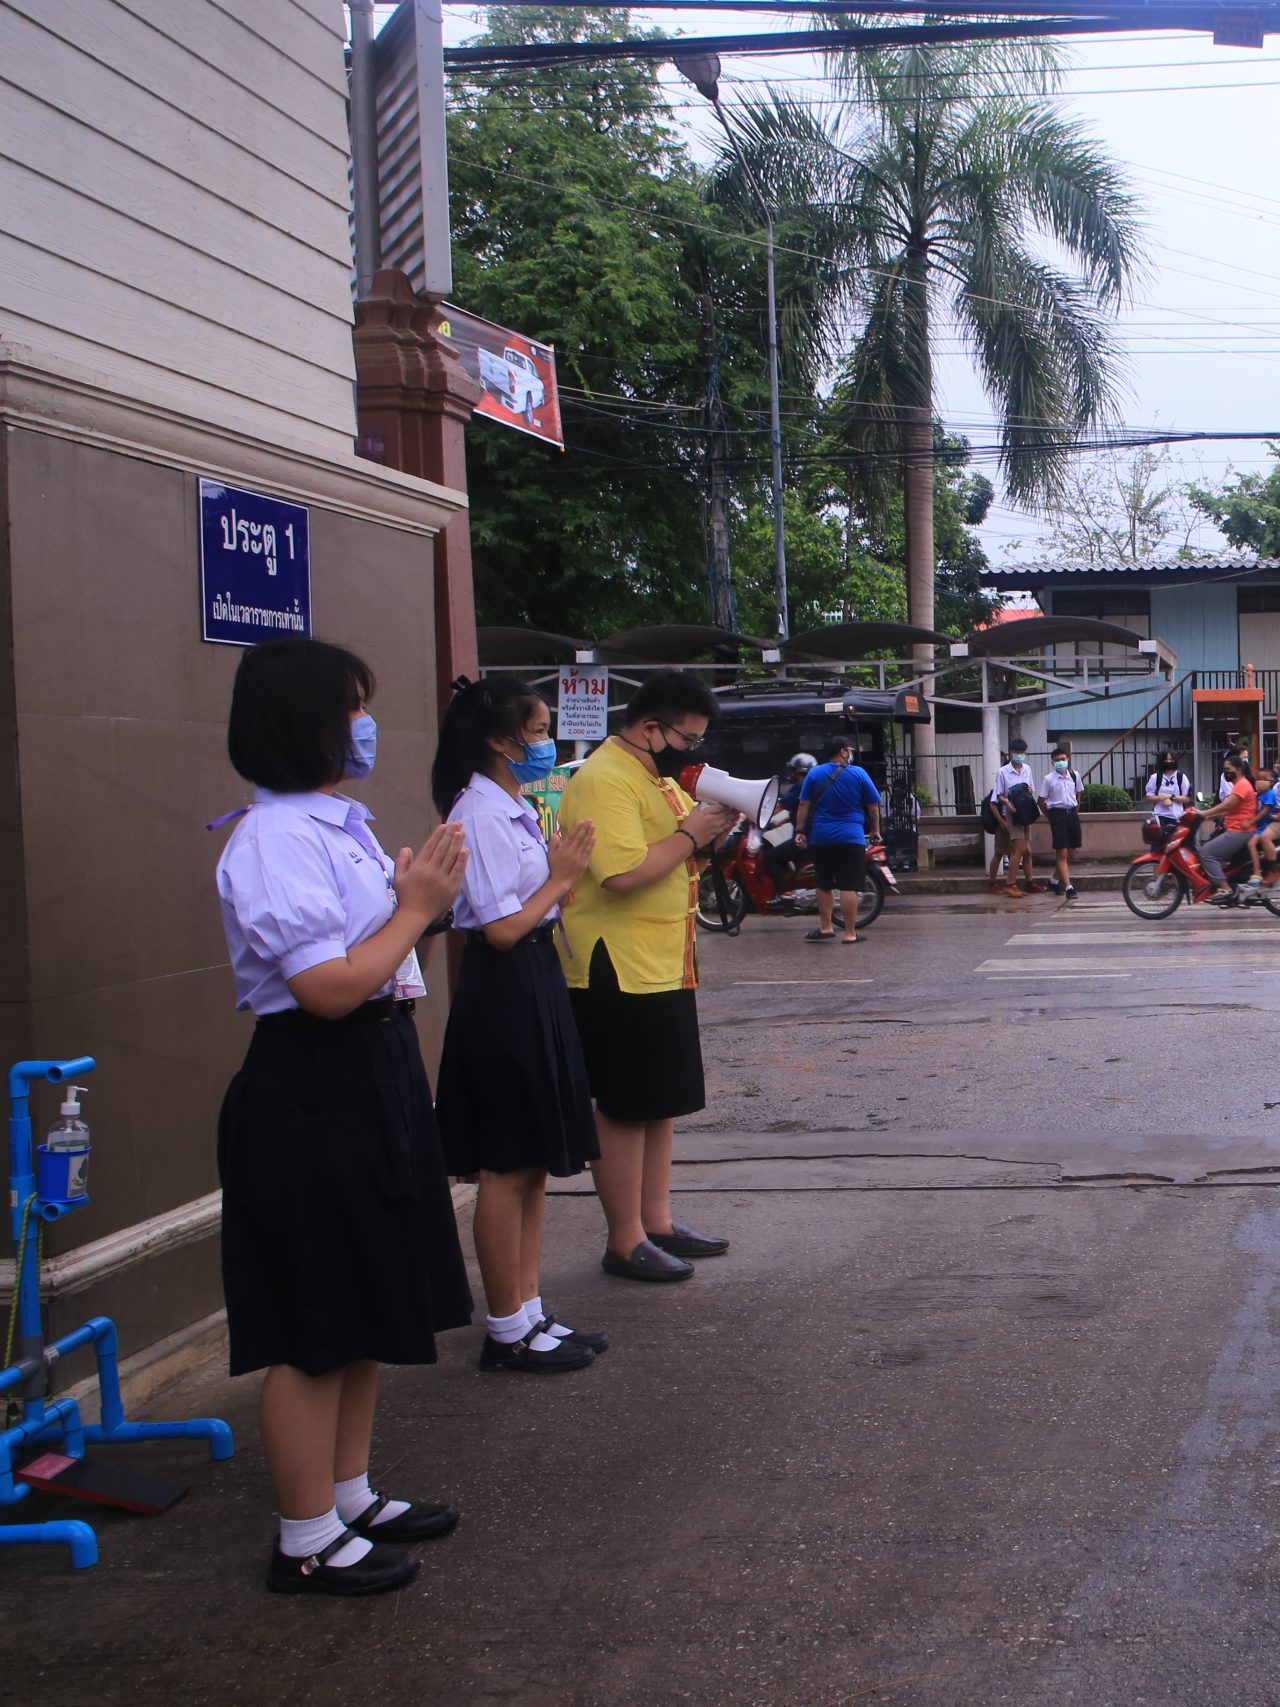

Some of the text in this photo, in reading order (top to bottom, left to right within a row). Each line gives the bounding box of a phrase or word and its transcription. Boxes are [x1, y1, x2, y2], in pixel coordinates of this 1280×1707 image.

[220, 508, 296, 577] ประตู 1
[212, 591, 305, 632] เปิดในเวลาราชการเท่านั้น
[562, 668, 606, 696] ห้าม
